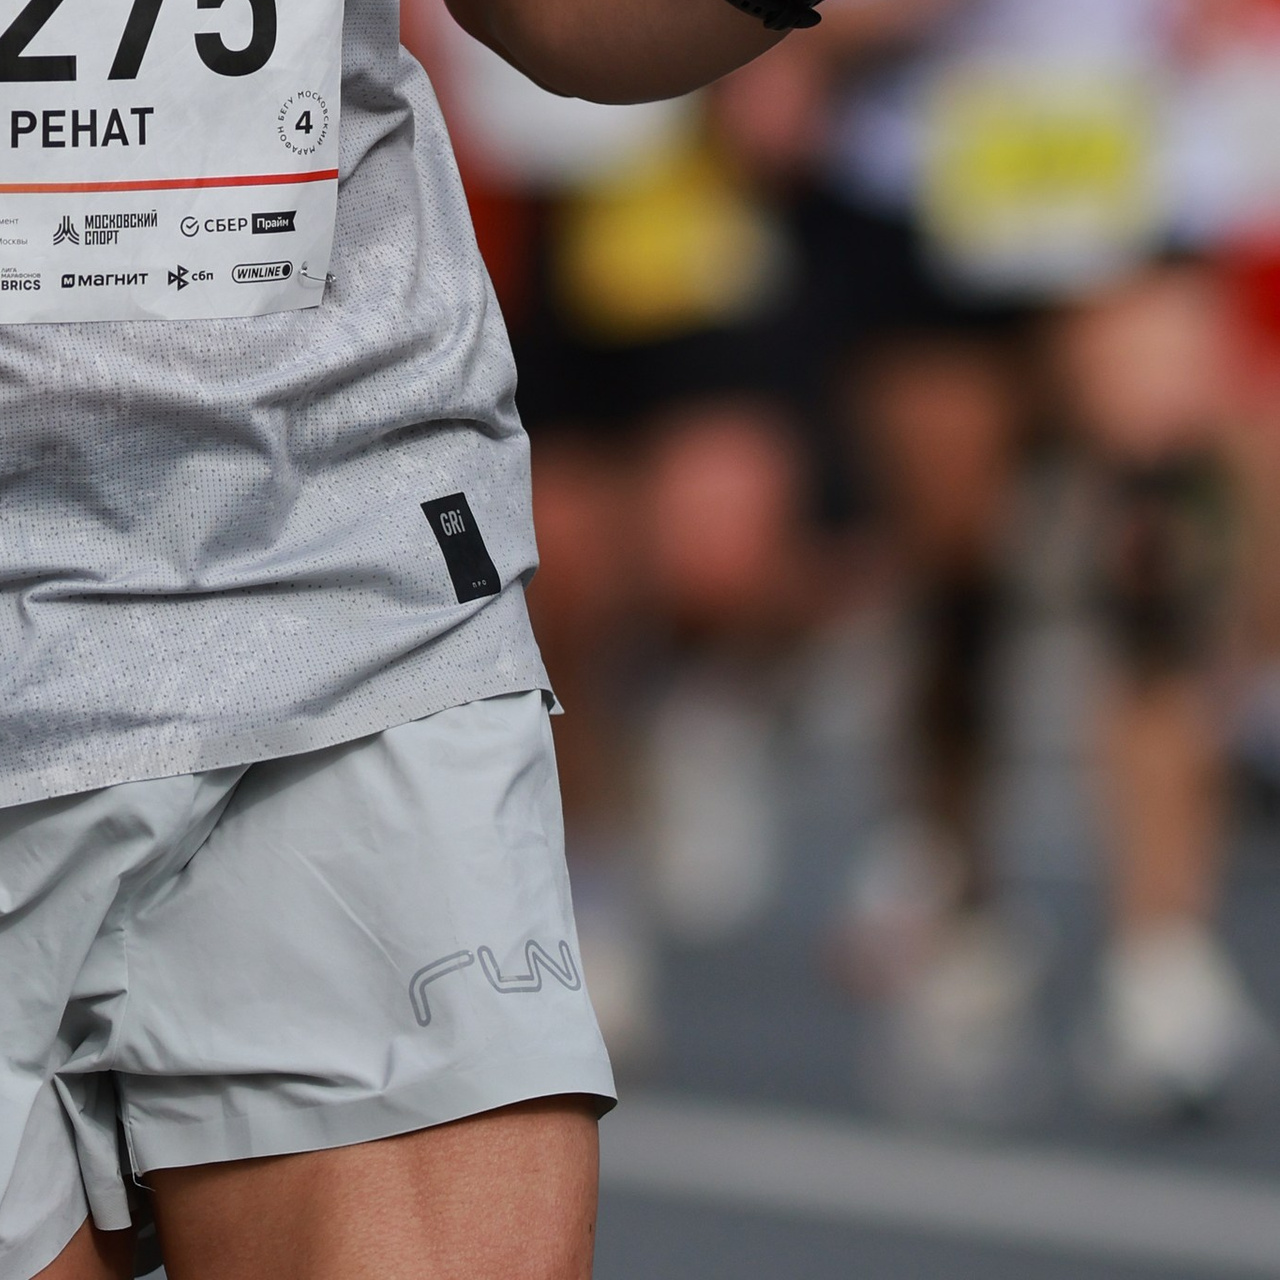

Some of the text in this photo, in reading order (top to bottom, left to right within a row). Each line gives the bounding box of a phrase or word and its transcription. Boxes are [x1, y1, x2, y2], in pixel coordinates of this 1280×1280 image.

[10, 107, 155, 149] РЕНАТ
[294, 109, 314, 135] 4
[84, 209, 158, 230] МОСКОВСКИЙ
[204, 216, 289, 233] СБЕР Прайм
[84, 230, 120, 246] СПОРТ
[236, 265, 281, 280] WINLINE
[1, 279, 41, 291] BRICS
